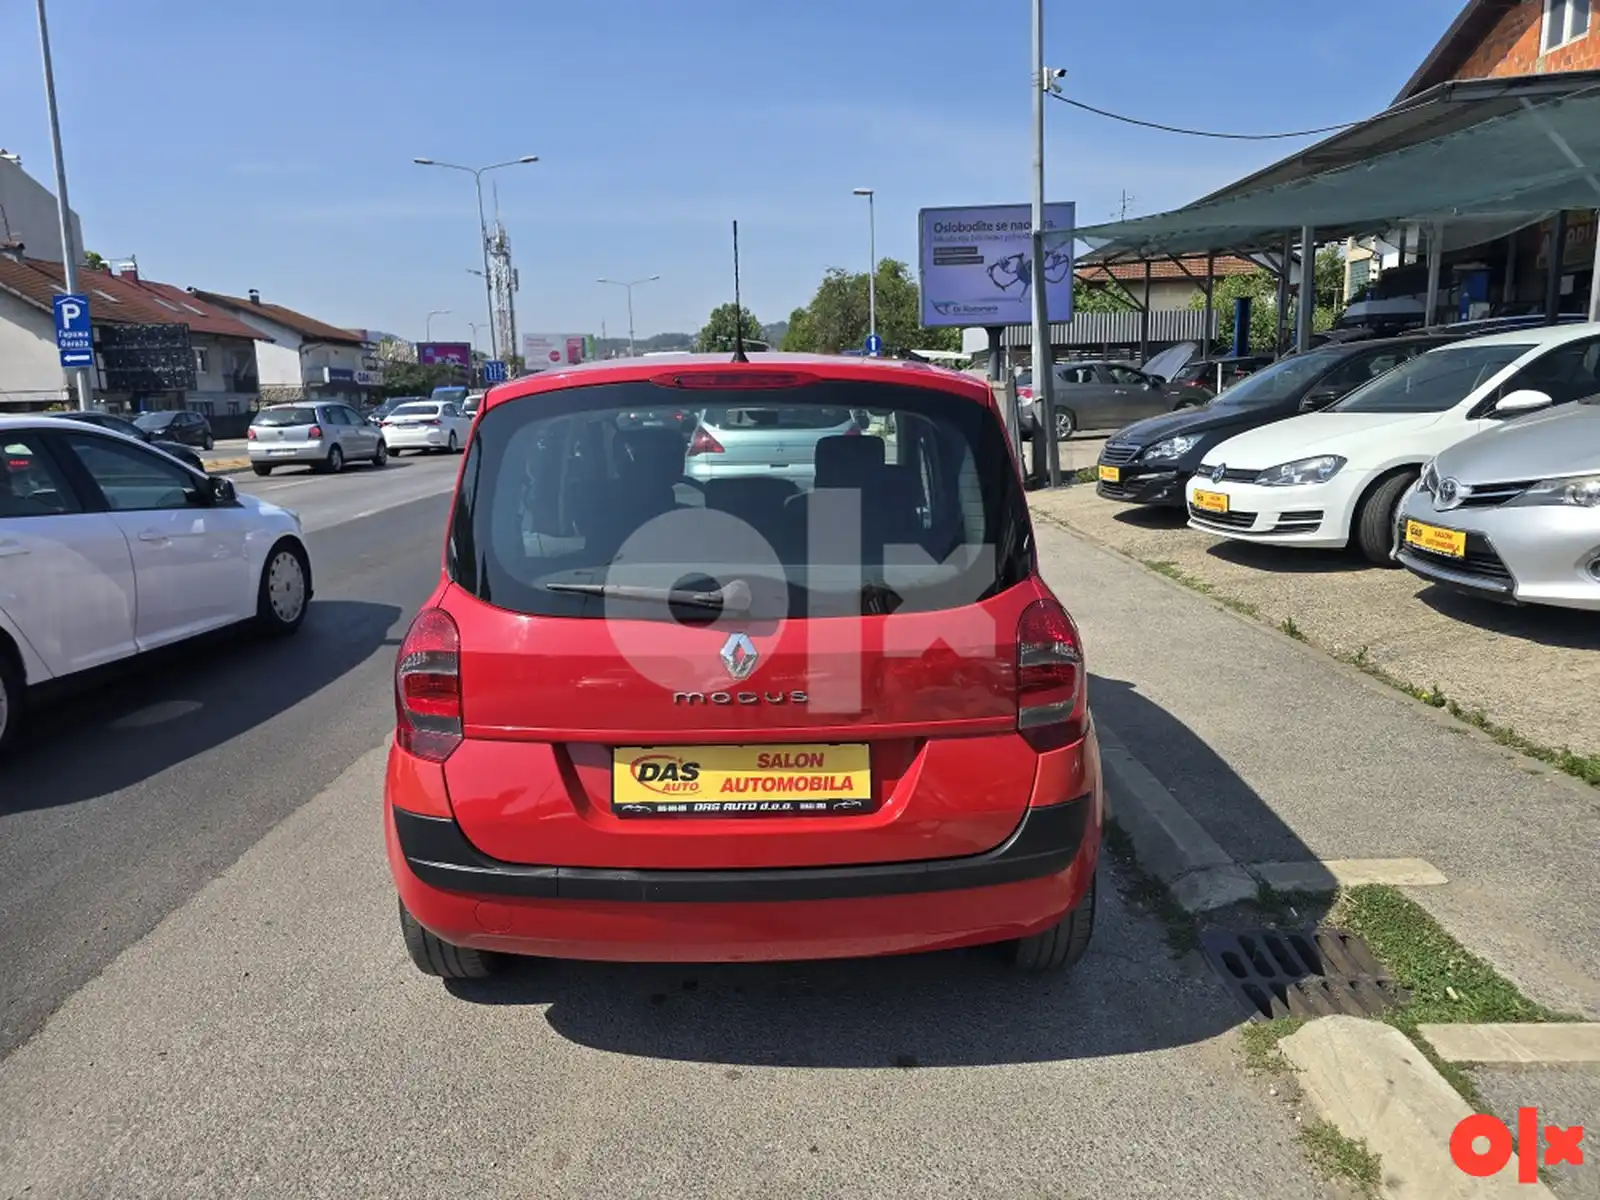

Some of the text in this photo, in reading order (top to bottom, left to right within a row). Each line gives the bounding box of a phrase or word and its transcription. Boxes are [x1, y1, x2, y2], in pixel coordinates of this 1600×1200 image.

[995, 221, 1008, 232] se
[61, 303, 81, 329] P
[757, 752, 825, 768] SALON
[662, 782, 699, 791] AUTO
[720, 775, 853, 793] AUTOMOBILA
[723, 802, 758, 811] AUTO
[760, 801, 794, 811] d.o.o.
